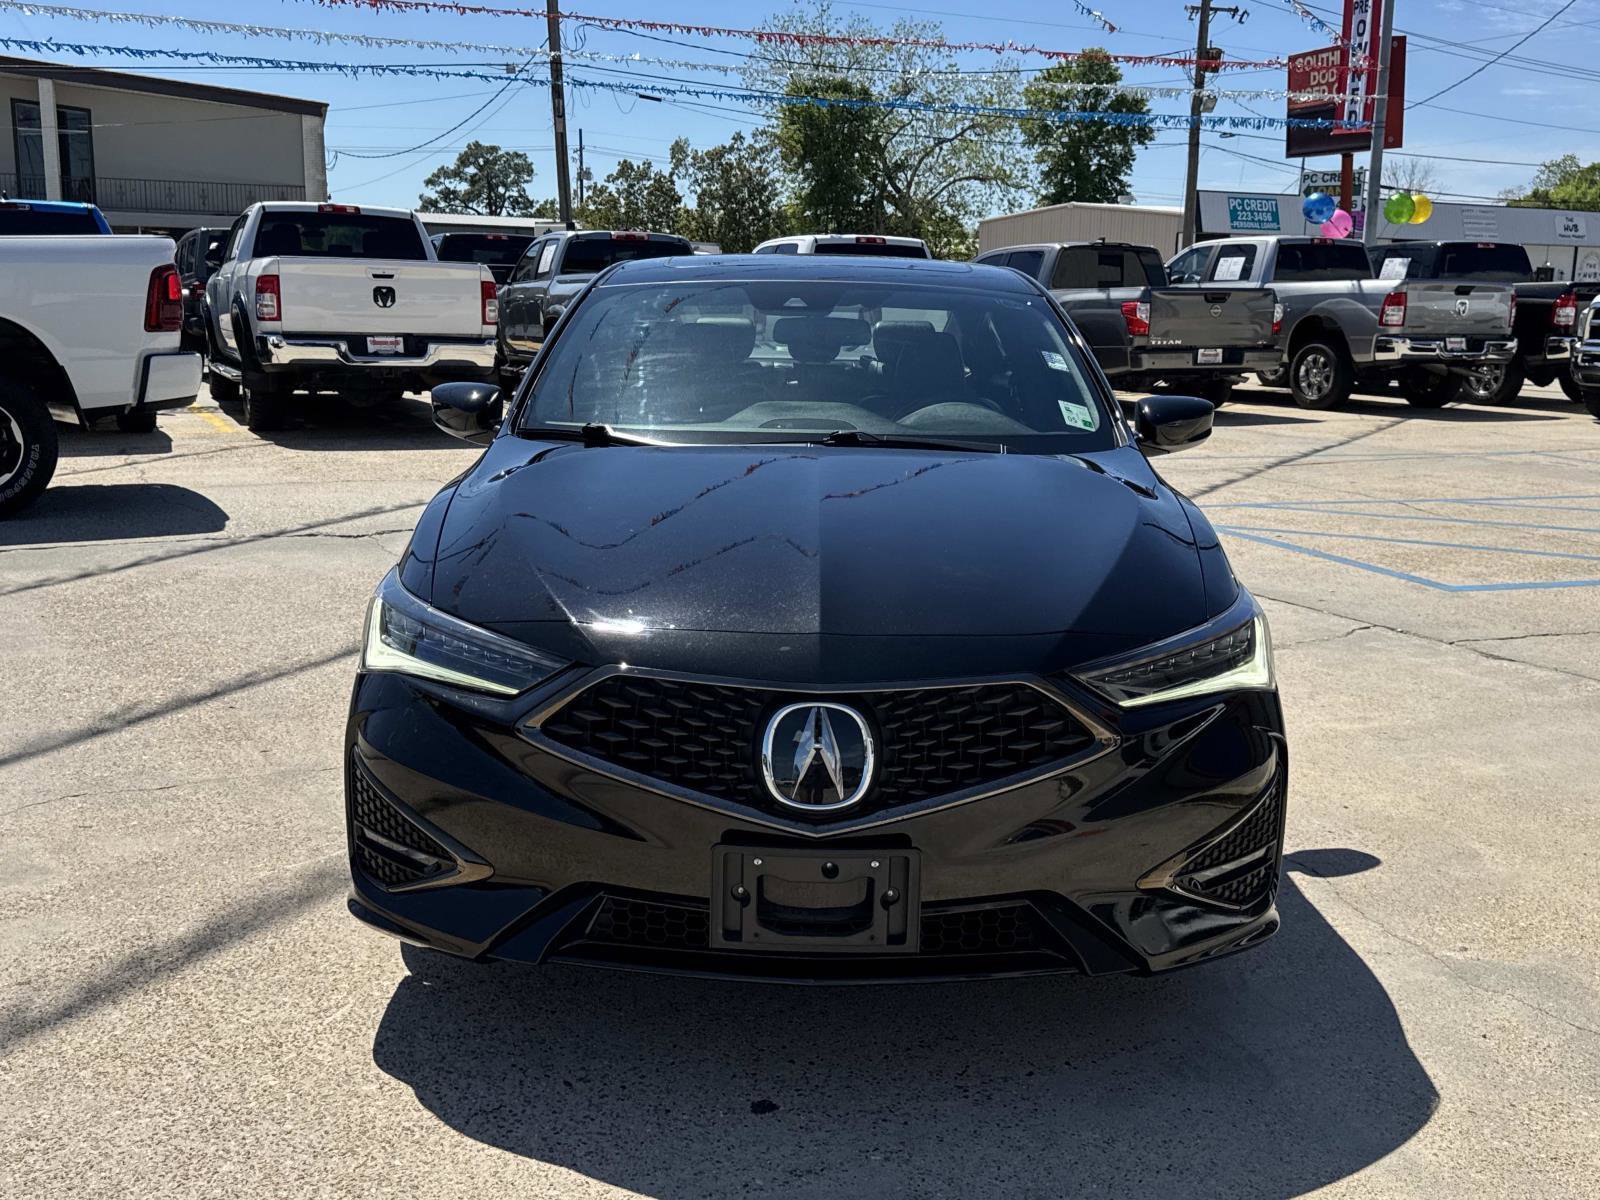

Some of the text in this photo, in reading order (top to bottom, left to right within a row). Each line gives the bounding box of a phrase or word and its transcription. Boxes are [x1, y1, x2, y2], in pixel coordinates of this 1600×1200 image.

[1302, 172, 1364, 184] PC CREIT
[1229, 198, 1277, 212] PC CREDIT
[1237, 211, 1272, 222] 223-3456
[1563, 224, 1579, 233] HUB
